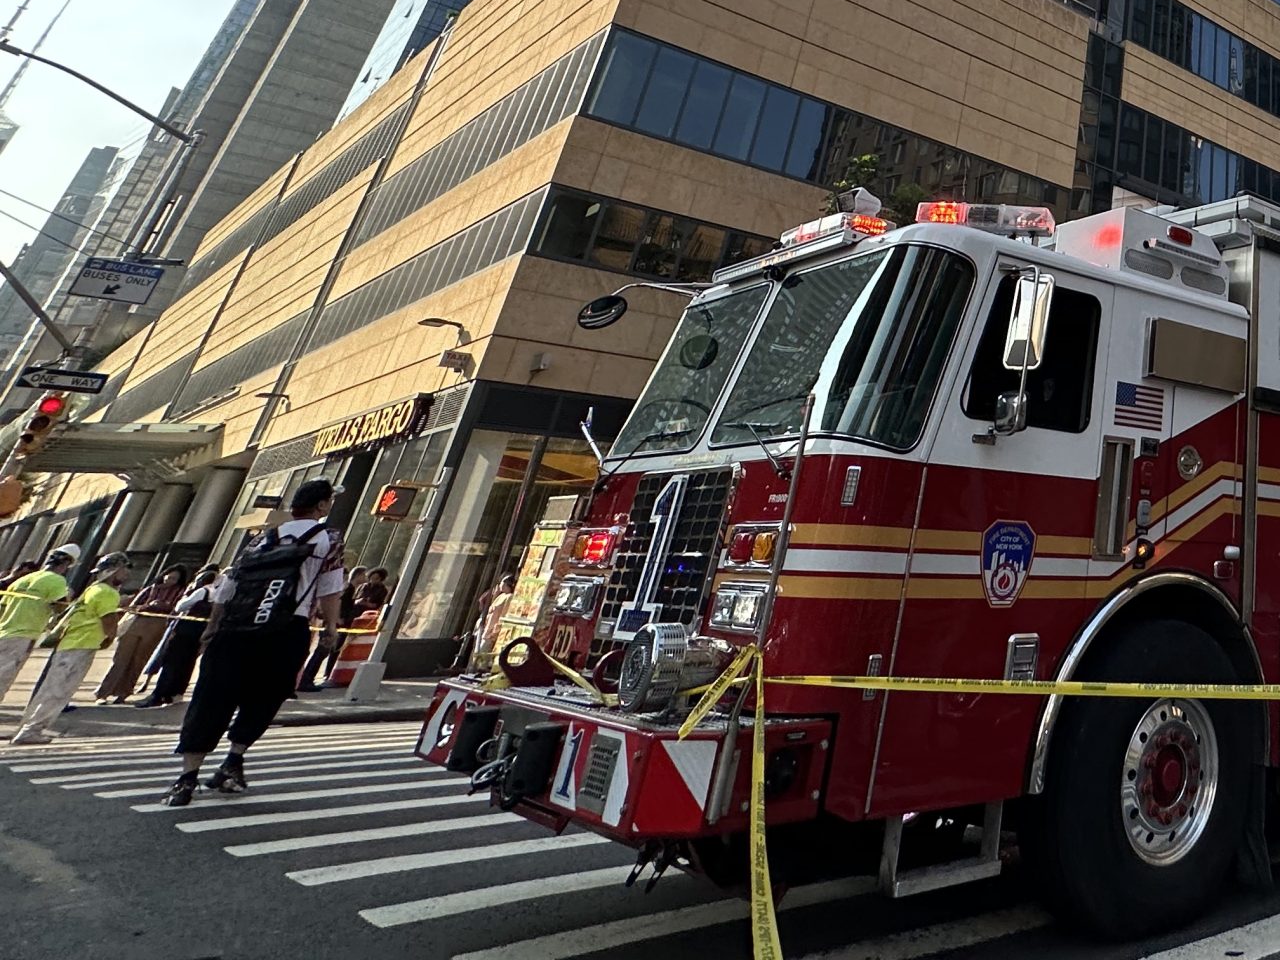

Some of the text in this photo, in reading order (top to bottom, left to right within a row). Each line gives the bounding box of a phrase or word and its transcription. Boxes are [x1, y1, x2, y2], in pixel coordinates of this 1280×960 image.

[82, 269, 155, 287] BUSES ONLY
[105, 262, 157, 277] BUS LANE
[30, 373, 97, 387] ONE WAY
[311, 399, 415, 457] WELLS FARGO
[612, 474, 689, 641] 1
[555, 728, 585, 799] 1
